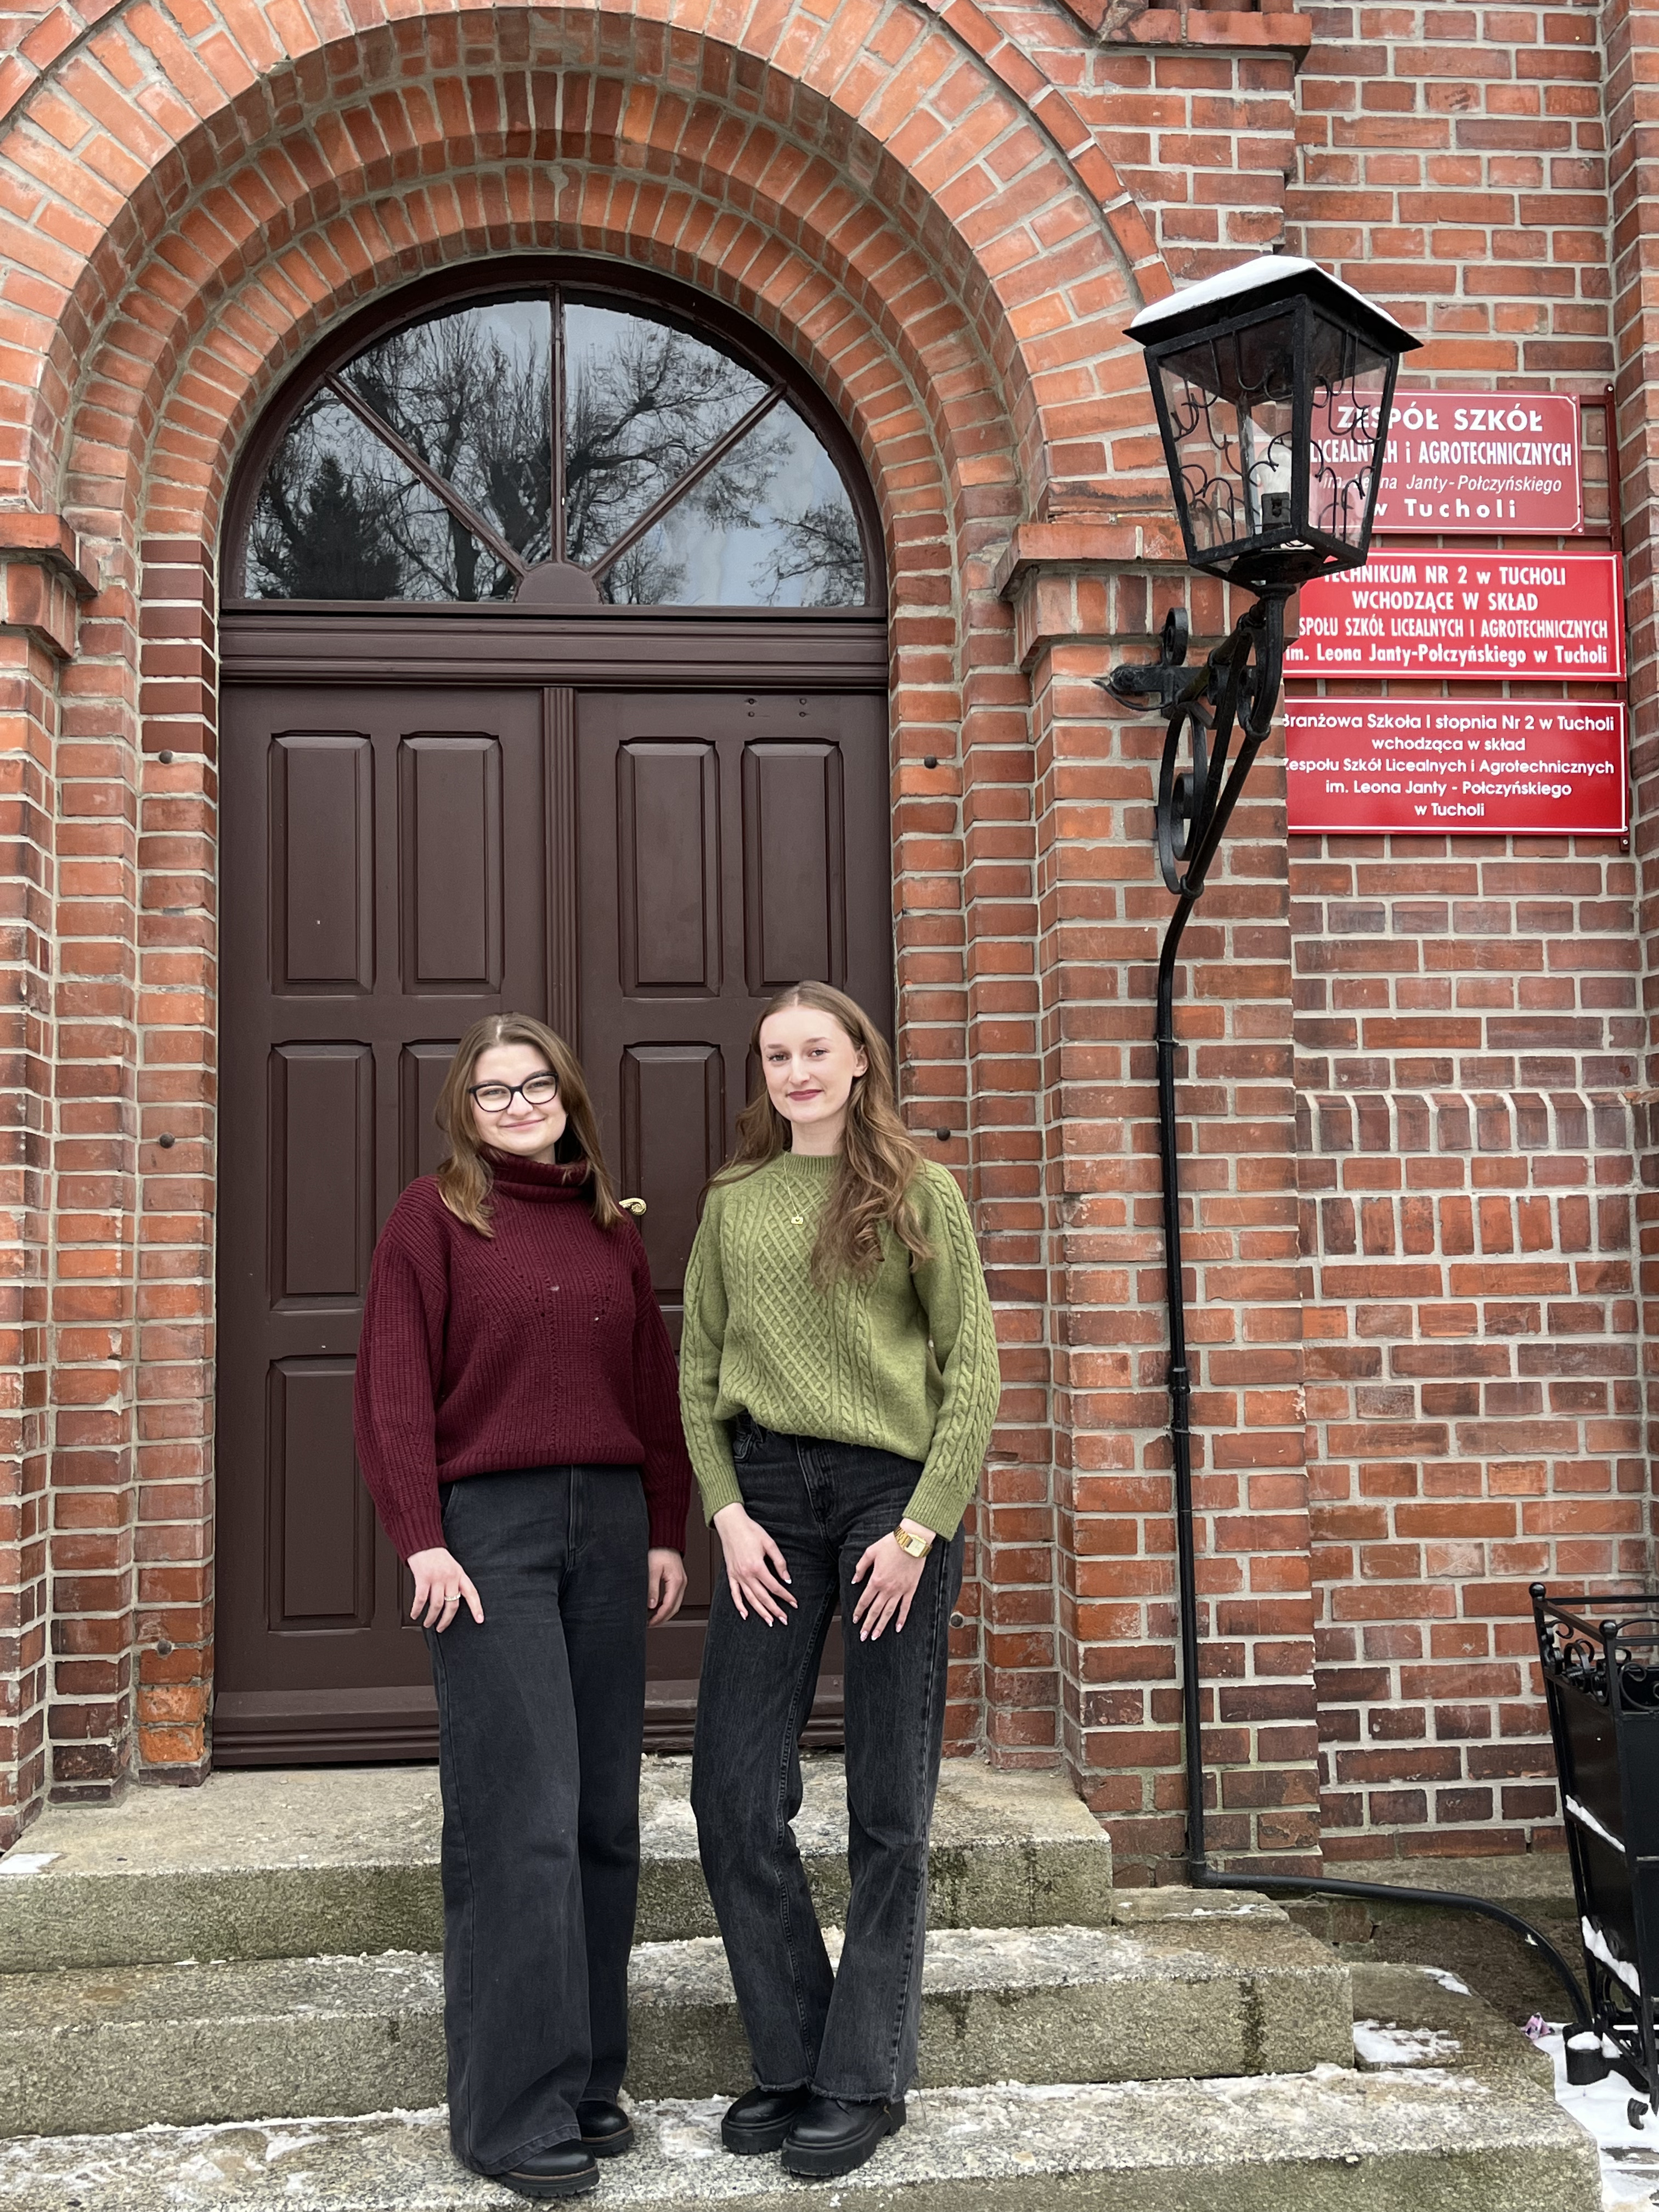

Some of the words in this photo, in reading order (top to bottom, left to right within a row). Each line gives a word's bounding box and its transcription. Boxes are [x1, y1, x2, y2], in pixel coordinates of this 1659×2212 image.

[1337, 401, 1439, 430] ZESPÓŁ
[1454, 403, 1543, 431] SZKÓŁ
[1310, 439, 1398, 463] LICEALNH
[1405, 441, 1411, 463] i
[1419, 441, 1572, 466] AGROTECHNICZNYCH
[1353, 473, 1398, 489] Lena
[1406, 474, 1562, 495] Janty-Połczyńskiego
[1404, 498, 1516, 517] Tucholi
[1425, 566, 1449, 584] NR
[1457, 566, 1468, 584] 2
[1476, 571, 1492, 584] w
[1499, 567, 1566, 585] TUCHOLI
[1352, 591, 1454, 613] WCHODZĄCE
[1462, 592, 1479, 610] W
[1488, 592, 1538, 611] SKŁAD
[1345, 614, 1385, 636] SZKÓŁ
[1391, 618, 1464, 637] LICEALNYCH
[1470, 619, 1474, 637] I
[1481, 619, 1608, 639] AGROTECHNICZNYCH
[1286, 645, 1310, 661] im.
[1317, 643, 1362, 661] Leona
[1369, 643, 1526, 668] Janty-Połczyńskiego
[1533, 650, 1548, 663] w
[1554, 644, 1607, 663] Tucholi
[1367, 714, 1421, 729] Szkoła
[1426, 714, 1430, 729] I
[1435, 714, 1497, 732] stopnia
[1502, 715, 1520, 730] Nr
[1525, 715, 1535, 730] 2
[1539, 718, 1553, 730] w
[1557, 715, 1615, 731] Tucholi
[1372, 736, 1463, 753] wchodząca
[1468, 741, 1481, 751] w
[1485, 737, 1526, 751] skład
[1343, 758, 1381, 771] Szkół
[1386, 758, 1466, 775] Licealnych
[1471, 759, 1475, 772] i
[1479, 759, 1615, 776] Agrotechnicznych
[1325, 780, 1348, 793] im.
[1353, 780, 1401, 793] Leona
[1405, 780, 1447, 797] Janty
[1463, 780, 1572, 798] Połczyńskiego
[1414, 805, 1427, 816] w
[1431, 803, 1485, 816] Tucholi
